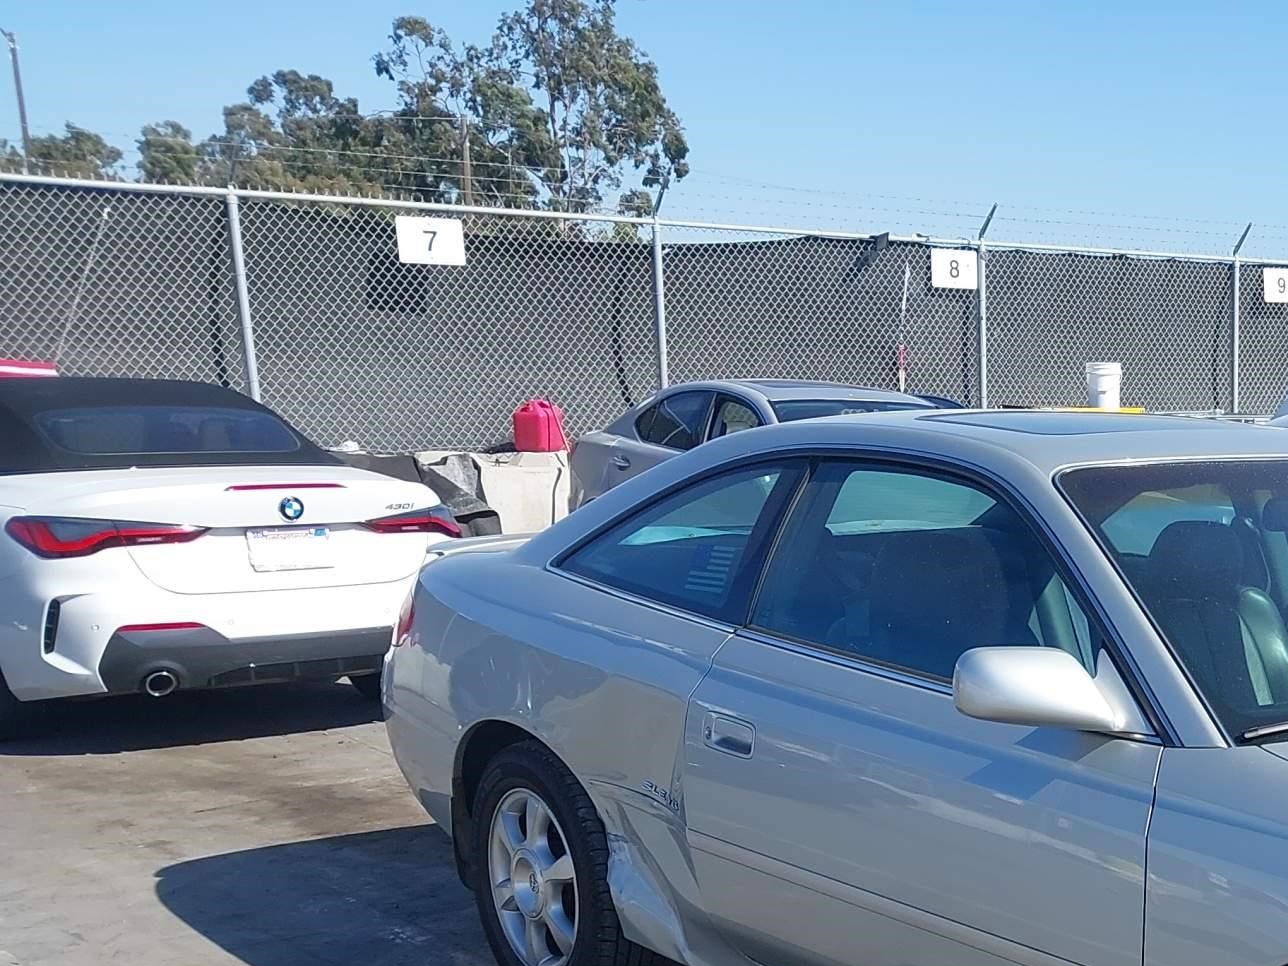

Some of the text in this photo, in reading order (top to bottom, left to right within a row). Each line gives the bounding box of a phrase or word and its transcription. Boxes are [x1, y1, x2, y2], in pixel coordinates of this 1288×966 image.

[422, 230, 437, 251] 7
[949, 259, 960, 278] 8
[1277, 277, 1286, 294] 9
[385, 502, 415, 510] 430i
